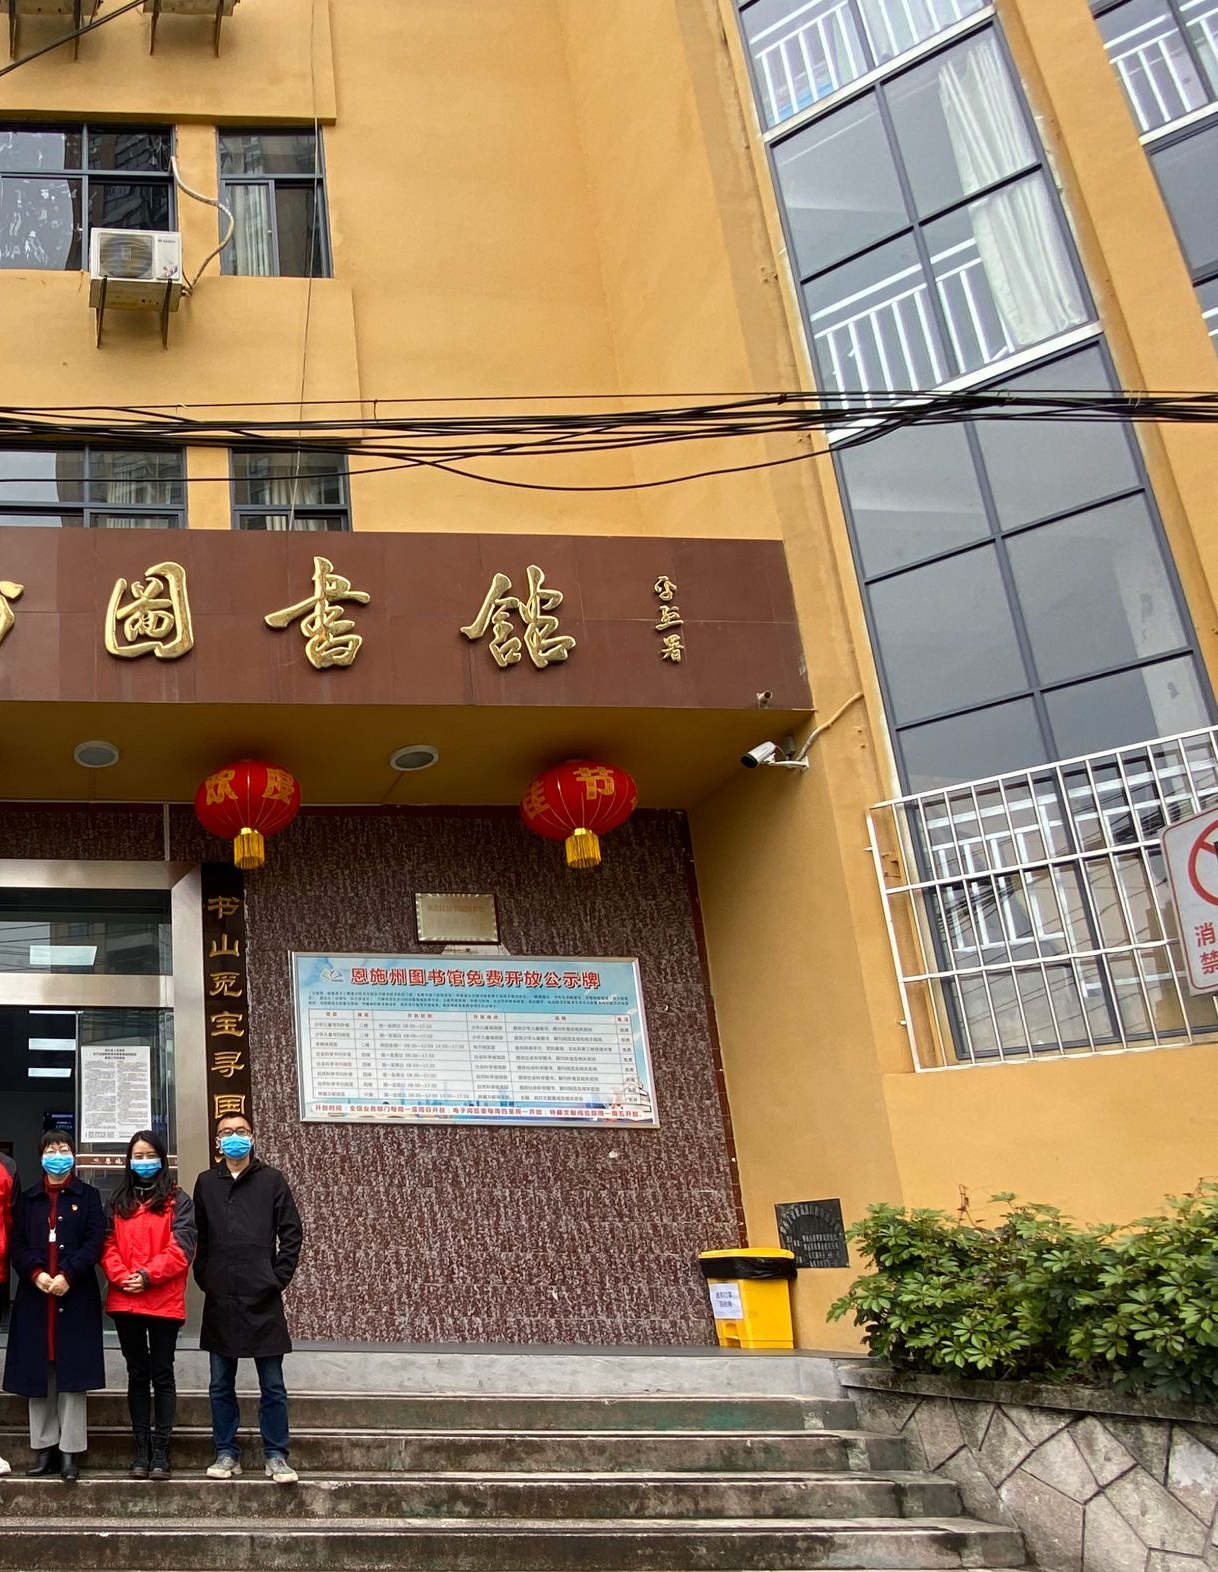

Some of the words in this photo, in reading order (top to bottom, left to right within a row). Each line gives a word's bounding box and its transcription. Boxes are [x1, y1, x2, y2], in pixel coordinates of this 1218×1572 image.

[1194, 922, 1216, 947] 消
[351, 967, 601, 989] 恩施州图书馆免费开放公示牌
[207, 896, 246, 1163] 书山觅宝寻国
